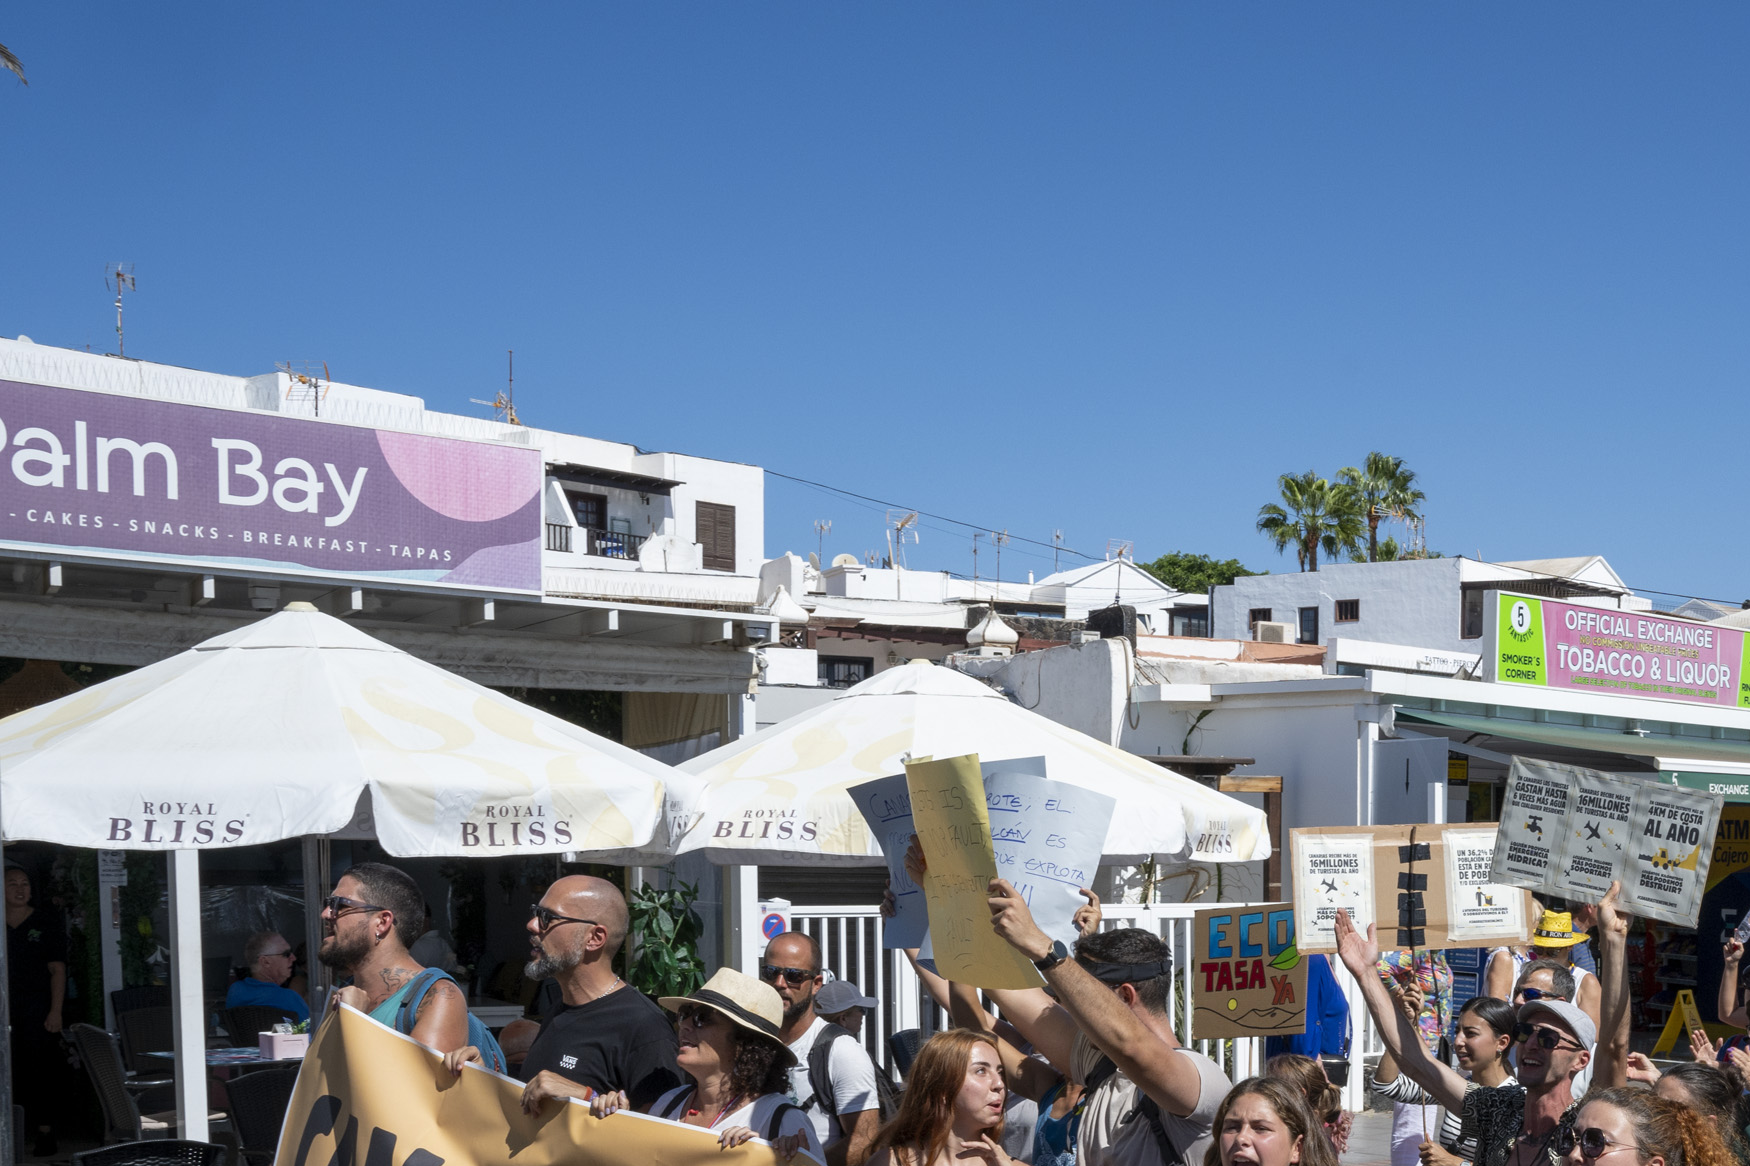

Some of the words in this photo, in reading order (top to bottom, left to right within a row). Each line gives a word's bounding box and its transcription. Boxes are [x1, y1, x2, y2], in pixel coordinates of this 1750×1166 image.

[0, 420, 179, 500] alm
[211, 437, 368, 527] Bay
[27, 509, 104, 528] CAKES
[129, 519, 218, 539] SNACKS
[244, 531, 367, 553] BREAKFAST
[390, 545, 452, 561] TAPAS
[1517, 606, 1524, 627] 5
[1565, 609, 1633, 639] OFFICIAL
[1638, 620, 1713, 649] EXCHANGE
[1506, 669, 1536, 680] CORNER
[1557, 643, 1645, 678] TOBACCO
[1651, 661, 1662, 680] &
[1666, 662, 1731, 689] LIQUOR
[1516, 782, 1543, 795] GASTAN
[1545, 787, 1567, 800] HASTA
[1709, 784, 1749, 795] EXCHANGE
[144, 802, 216, 815] ROYAL
[1519, 794, 1535, 802] VECES
[1536, 796, 1548, 805] MÁS
[1550, 799, 1565, 809] AGUA
[1579, 795, 1630, 814] 16MILLONES
[486, 806, 545, 818] ROYAL
[744, 809, 797, 818] ROYAL
[1584, 807, 1607, 818] TURISTAS
[1617, 812, 1628, 822] AÑO
[1648, 806, 1666, 817] 4KM
[1668, 810, 1678, 819] DE
[1680, 812, 1702, 825] COSTA
[107, 817, 245, 844] BLISS
[461, 821, 573, 846] BLISS
[713, 820, 818, 841] BLISS
[1209, 821, 1226, 830] ROYAL
[1643, 819, 1662, 838] AL
[1666, 822, 1699, 845] AÑO
[1717, 820, 1749, 840] ATM
[1196, 833, 1232, 853] BLISS
[1509, 846, 1548, 859] EMERGENCIA
[1310, 859, 1358, 867] 16MILLONES
[1507, 853, 1548, 868] HÍDRICA?
[1585, 860, 1612, 872] PODEMOS
[1713, 847, 1748, 866] Cajero
[1025, 859, 1085, 882] EXPLOTA
[1460, 871, 1469, 879] DE
[1571, 865, 1611, 878] SOPORTAR?
[1640, 880, 1682, 894] DESTRUIR?
[1654, 877, 1683, 888] PODEMOS
[1209, 909, 1295, 959] ECO
[1201, 959, 1266, 992] TASA
[1271, 975, 1295, 1005] YA
